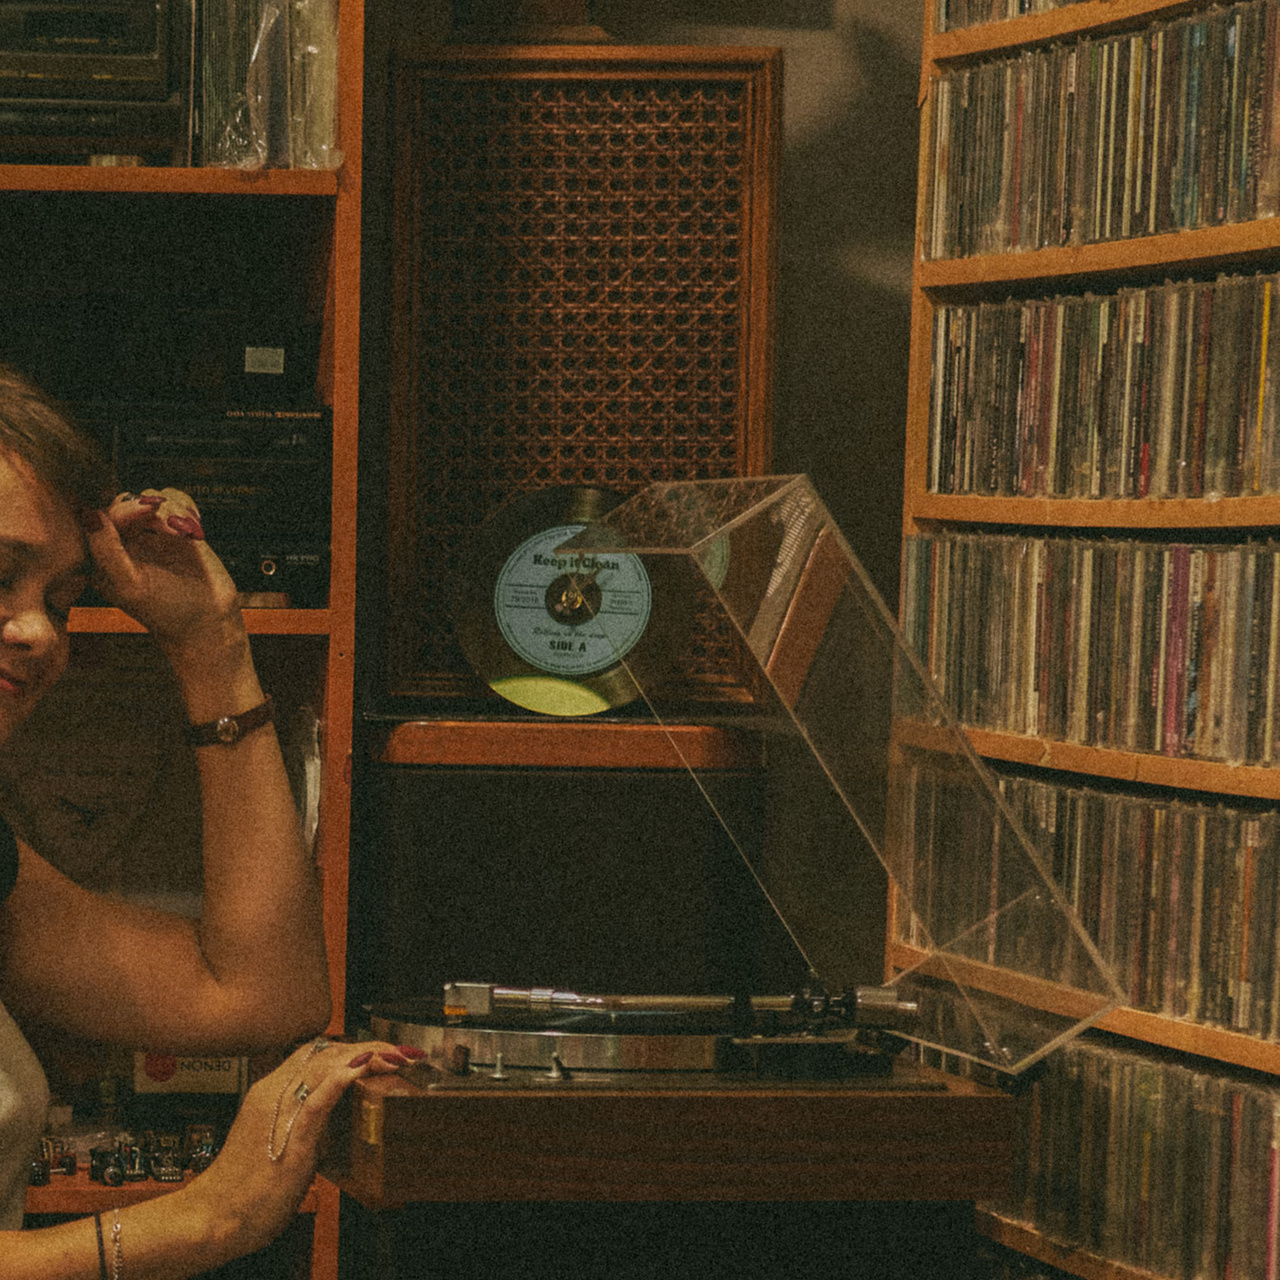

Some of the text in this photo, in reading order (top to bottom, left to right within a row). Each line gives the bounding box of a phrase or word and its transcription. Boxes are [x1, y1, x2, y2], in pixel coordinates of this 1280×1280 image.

[533, 555, 567, 571] Keep
[549, 640, 587, 652] SIDE A
[180, 1060, 232, 1072] DENON
